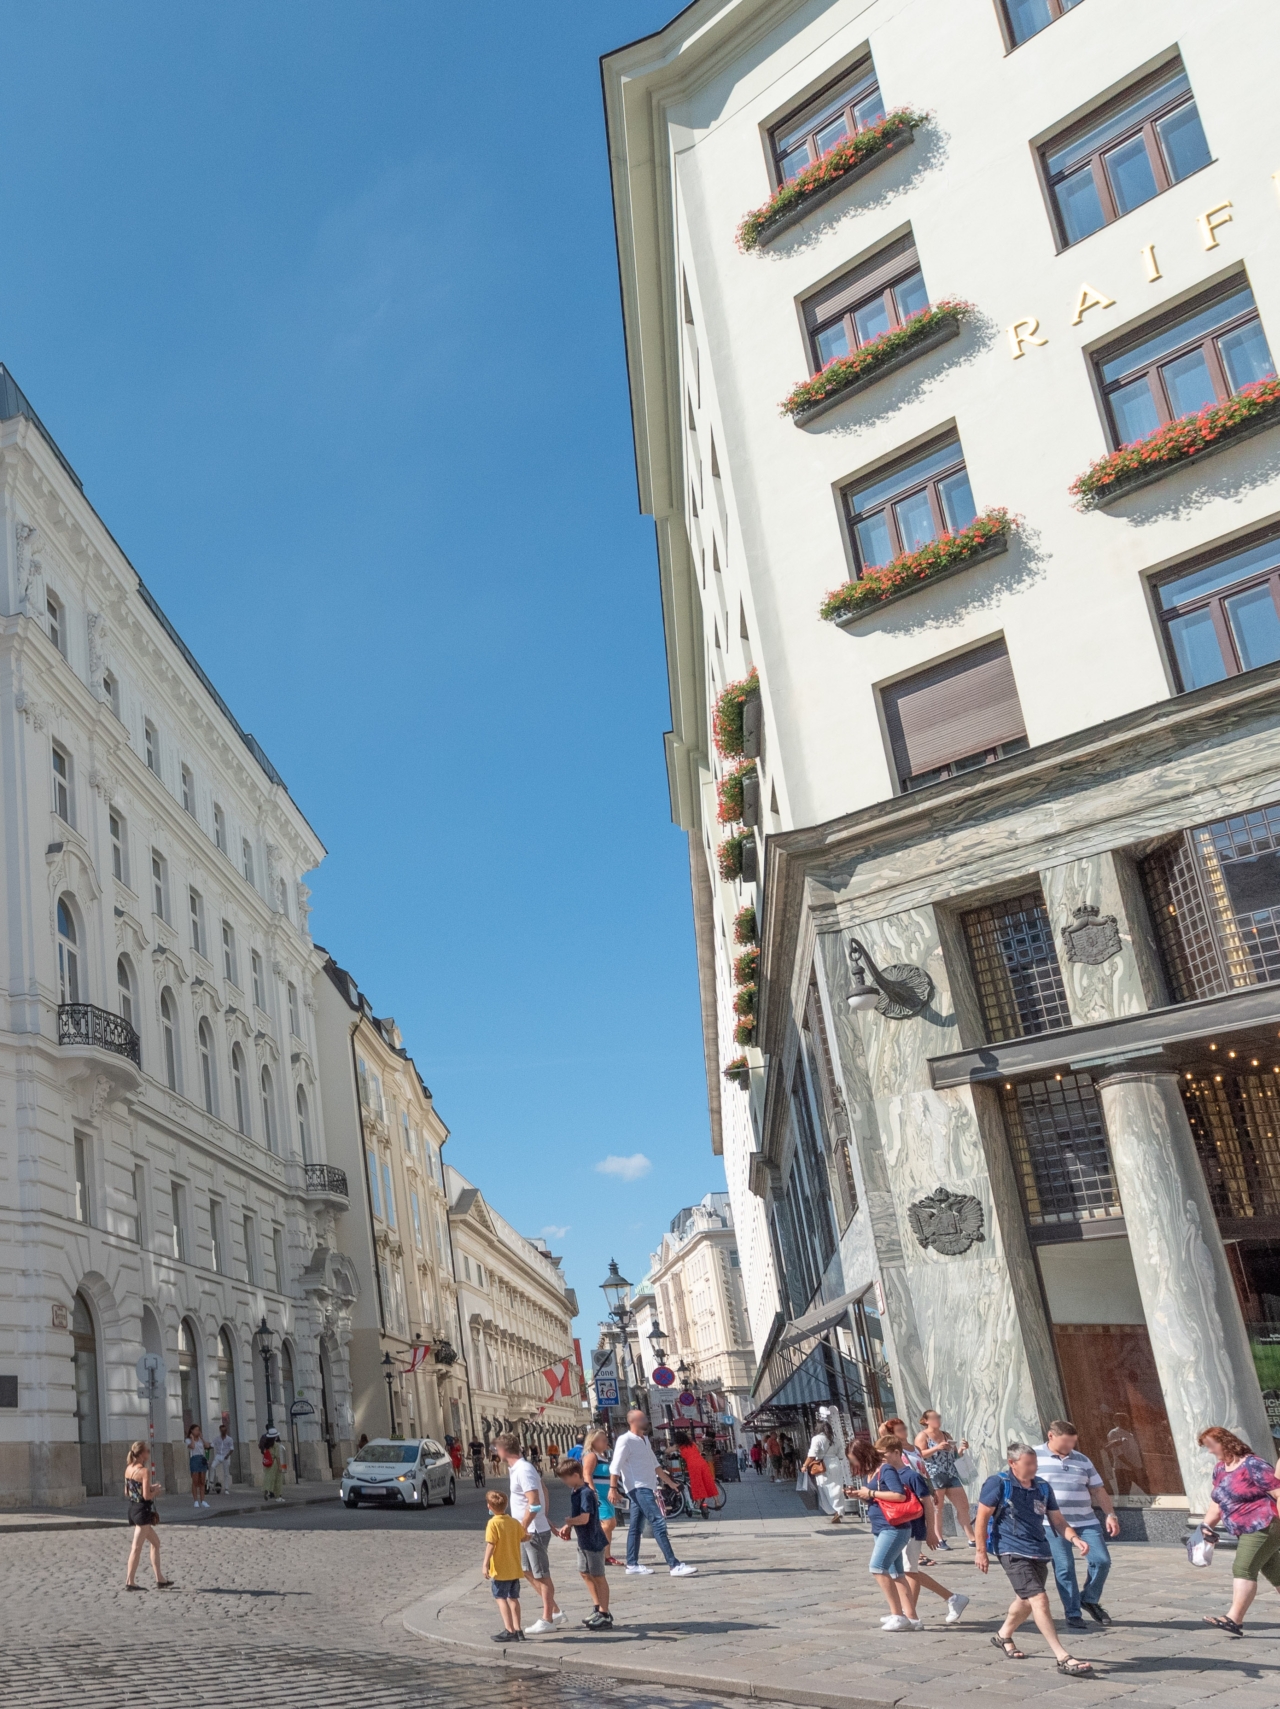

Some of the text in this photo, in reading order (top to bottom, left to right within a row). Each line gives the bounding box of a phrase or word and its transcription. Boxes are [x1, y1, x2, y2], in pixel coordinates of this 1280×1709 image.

[1005, 169, 1280, 360] RAIF
[596, 1369, 614, 1377] Zone
[1127, 1497, 1161, 1506] BANK
